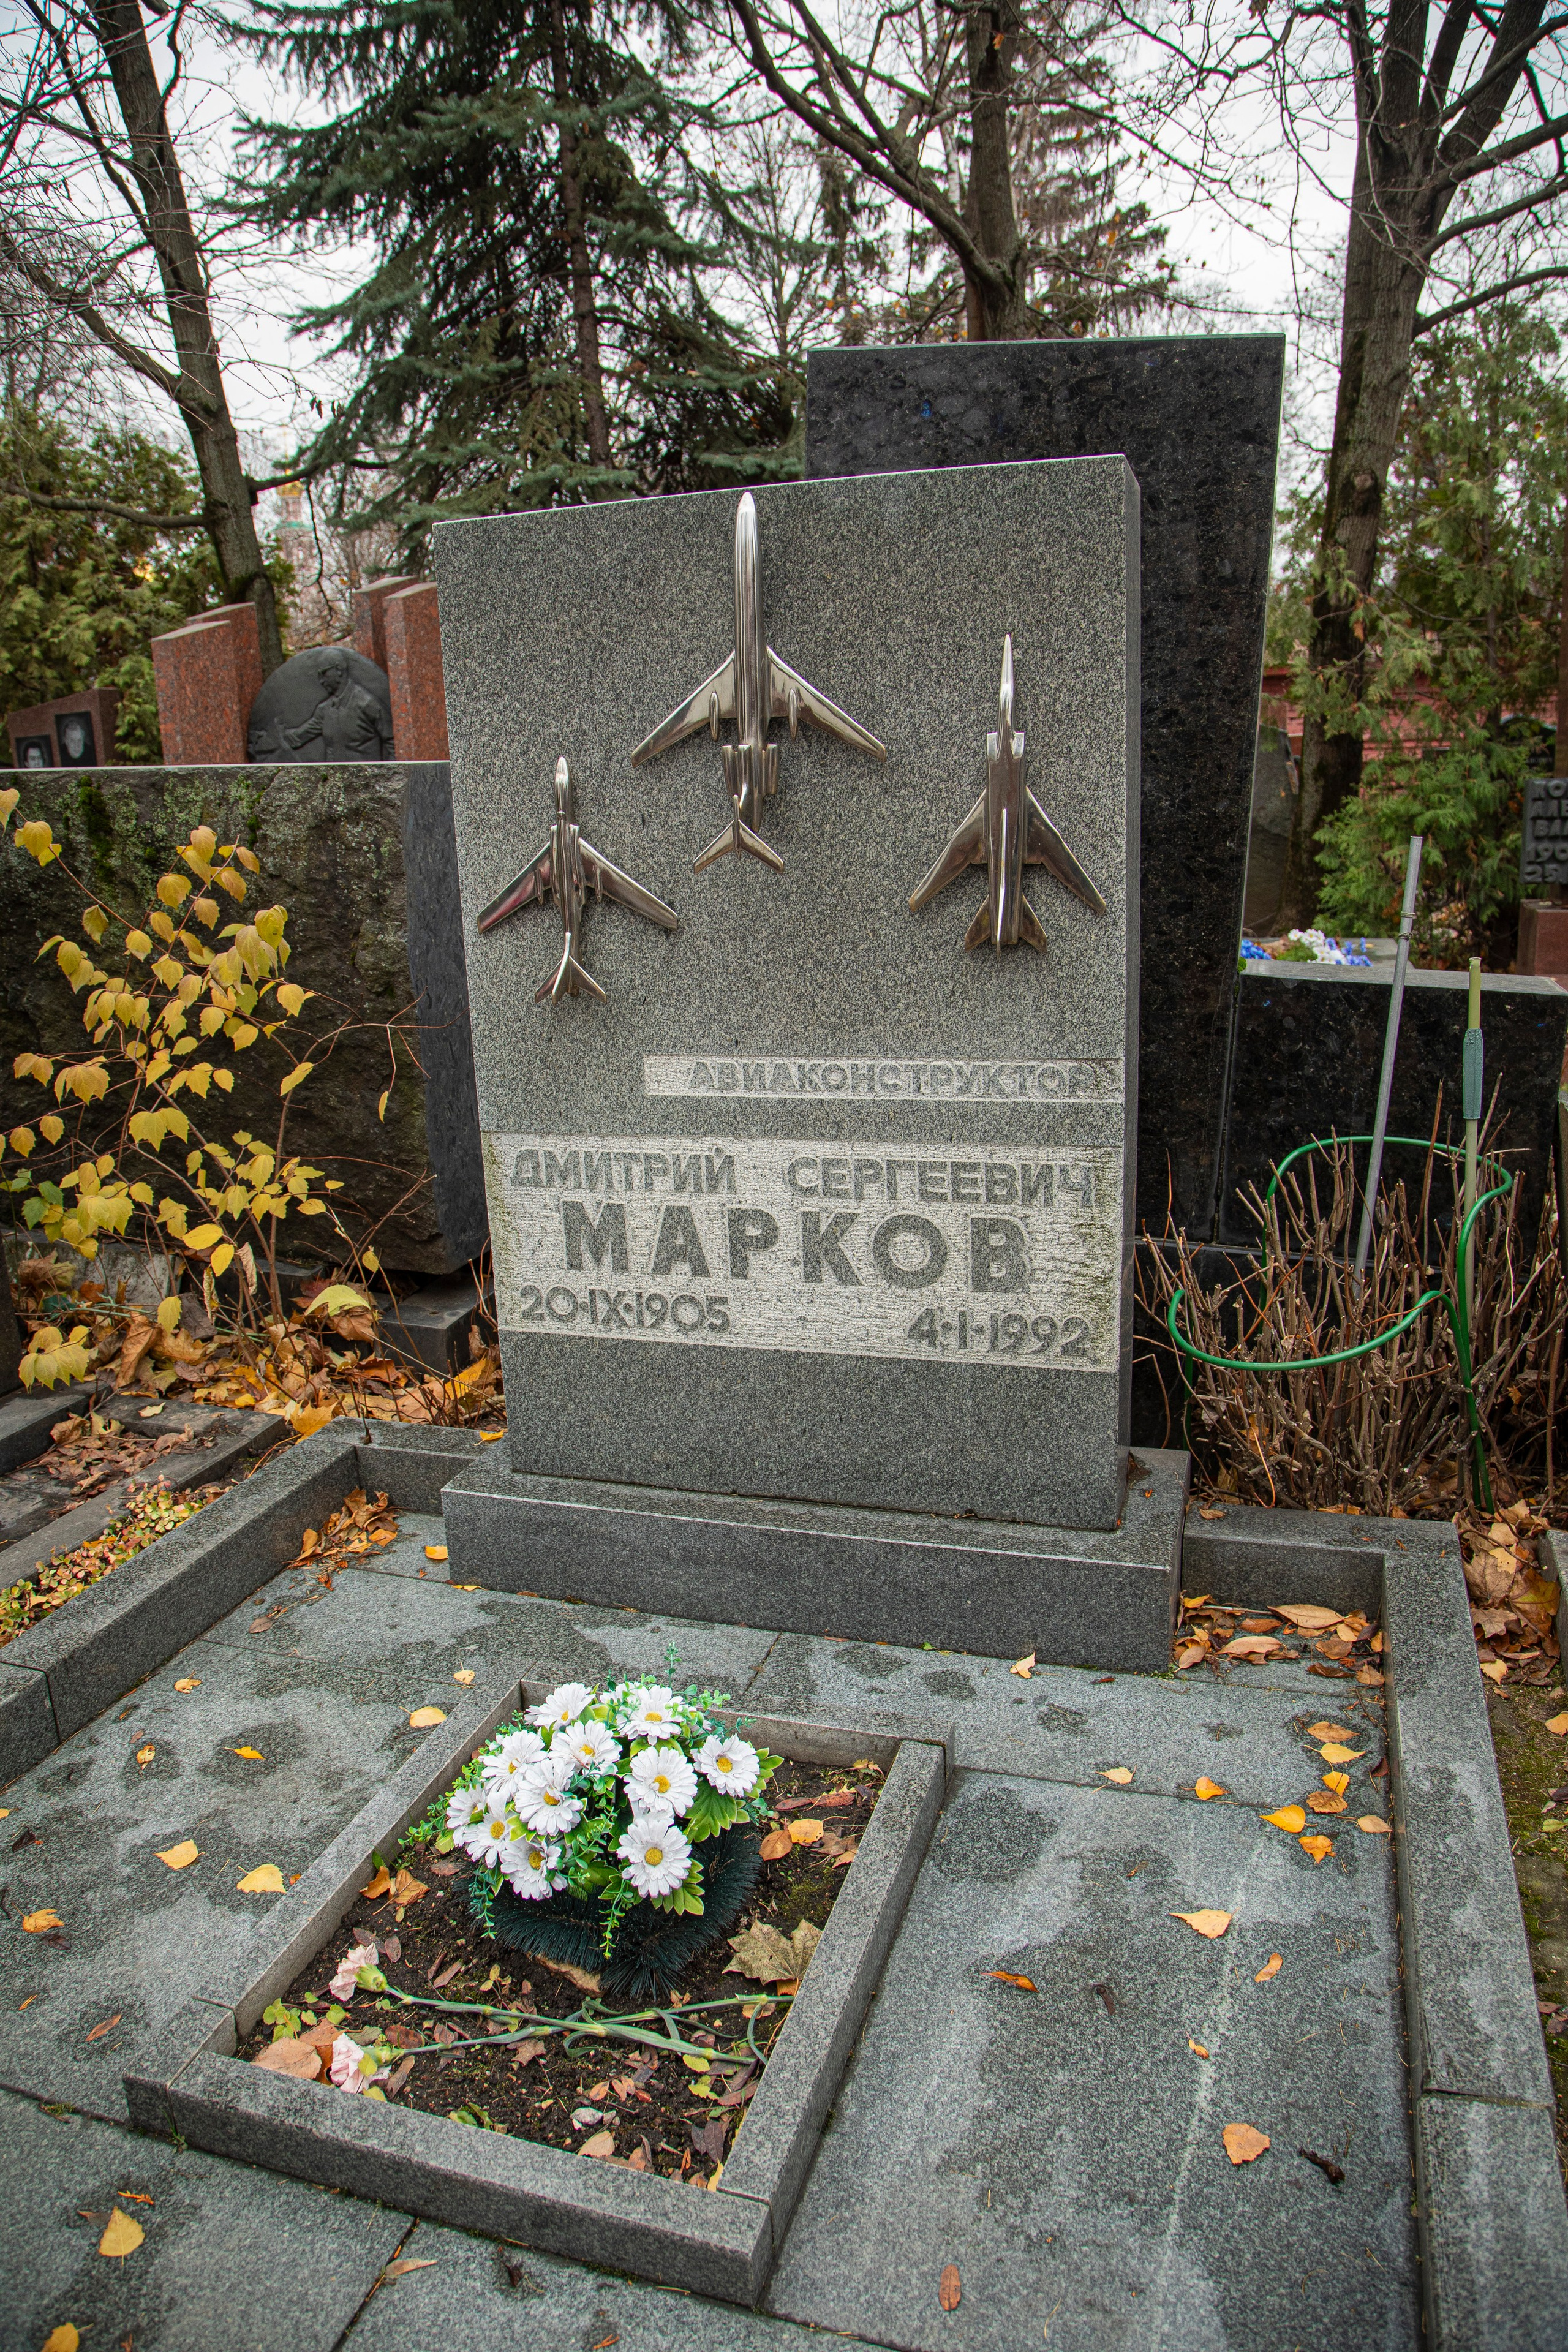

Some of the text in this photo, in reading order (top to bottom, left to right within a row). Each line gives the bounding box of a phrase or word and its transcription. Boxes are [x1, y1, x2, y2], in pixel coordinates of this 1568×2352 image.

[688, 1061, 1096, 1096] АВИАКОНСТРУКТОР
[510, 1147, 1095, 1207] ДМИТРИЙ СЕРГЕЕВИЧ
[561, 1200, 1030, 1293] МАРКОВ
